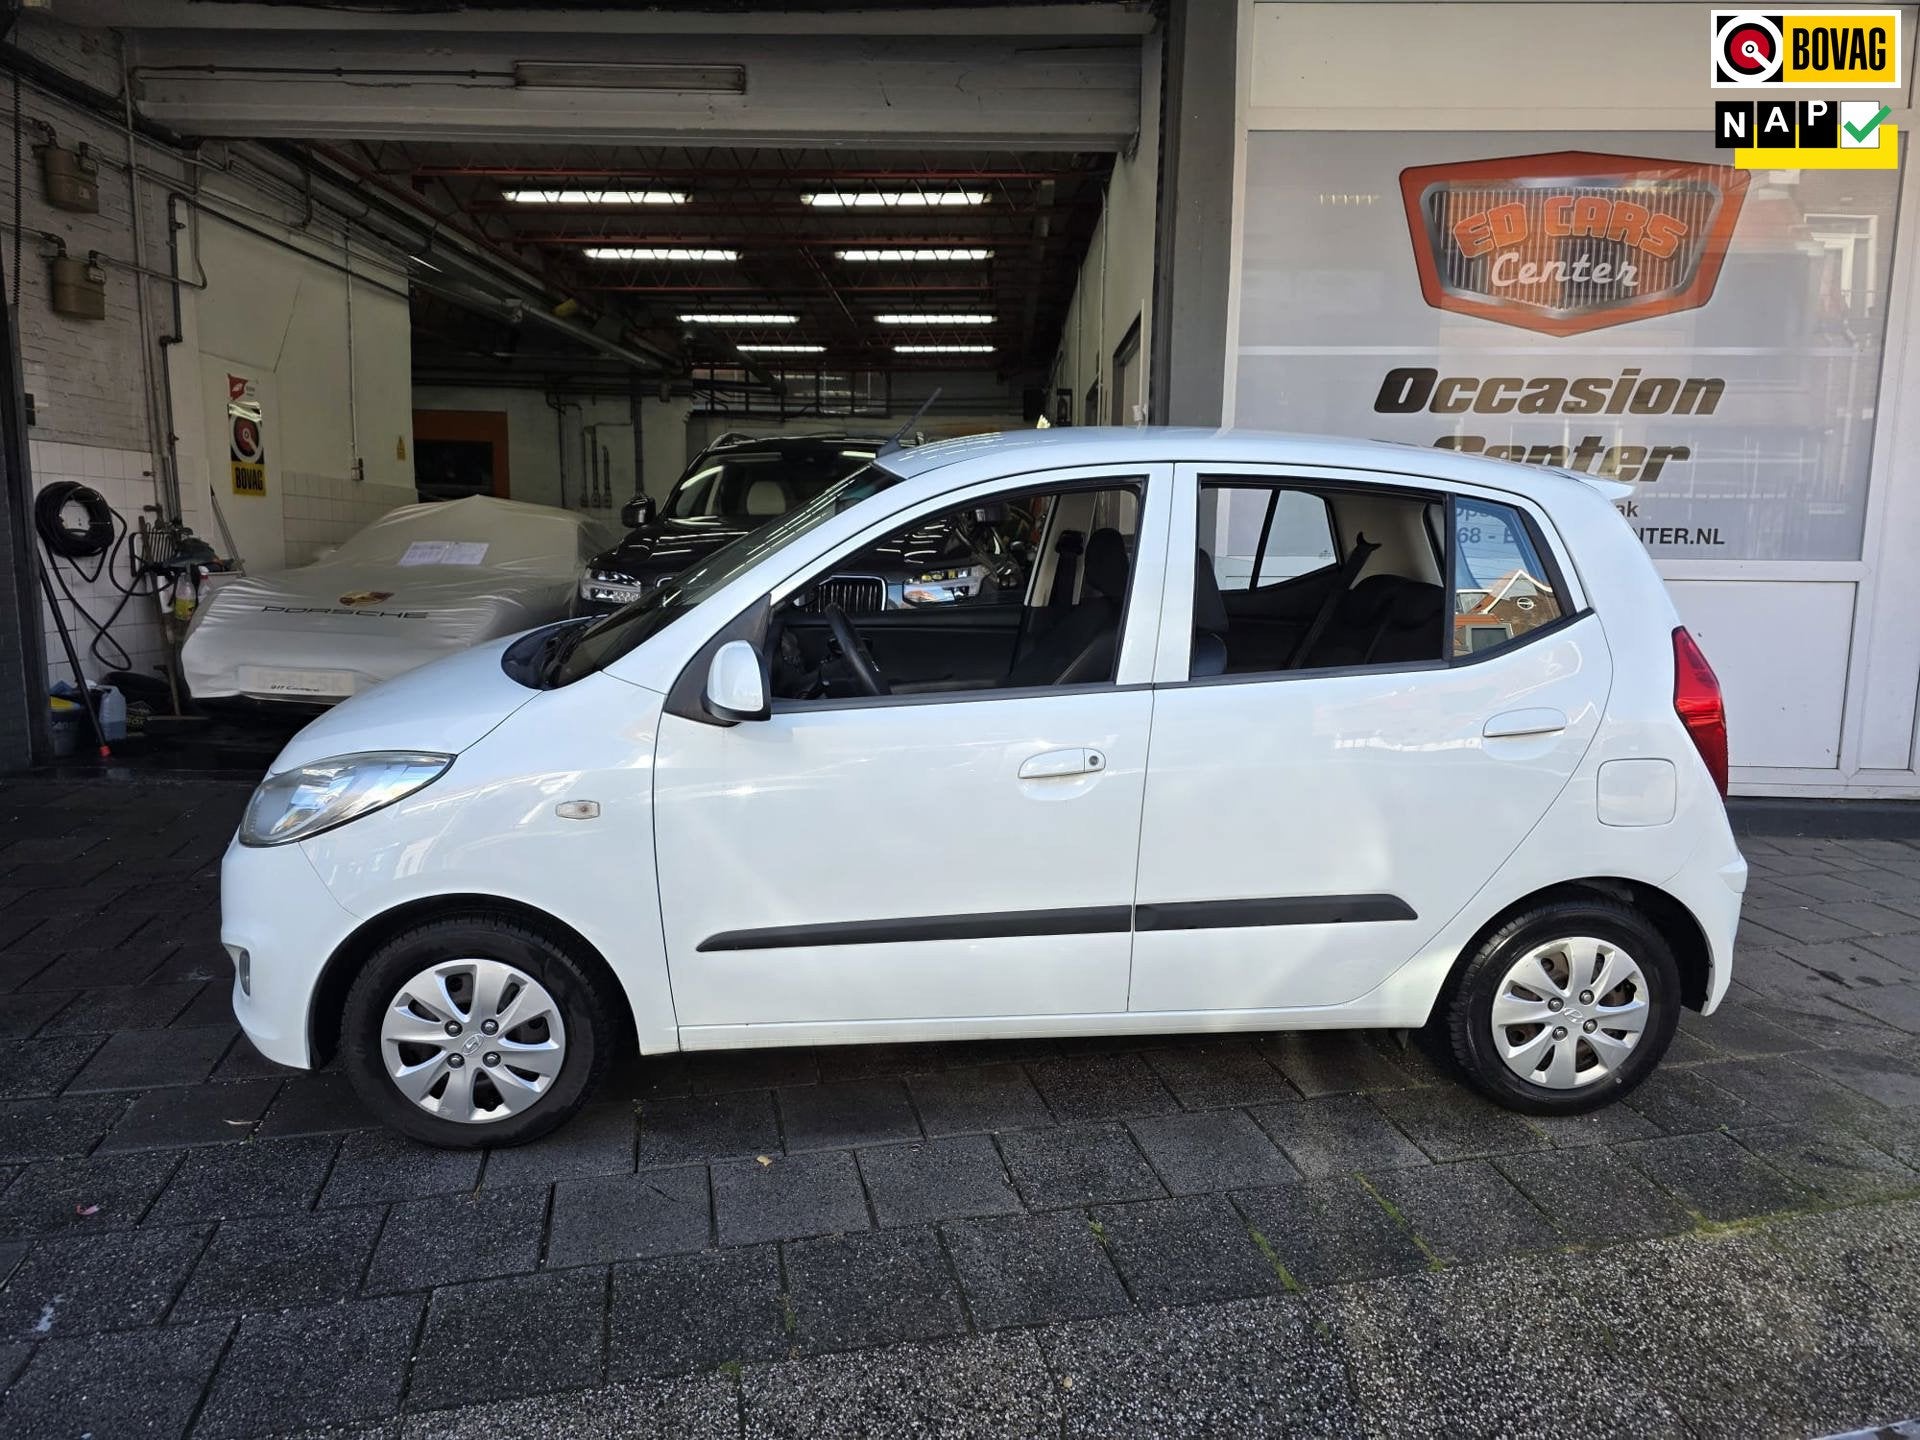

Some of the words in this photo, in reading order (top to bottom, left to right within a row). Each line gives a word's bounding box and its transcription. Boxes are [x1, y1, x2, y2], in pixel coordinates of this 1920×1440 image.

[1453, 202, 1528, 259] ED
[1544, 196, 1688, 259] CARS
[1491, 252, 1639, 287] Center
[1374, 368, 1726, 416] Occasion
[234, 466, 264, 492] BOVAG
[261, 605, 430, 619] PORSCHE
